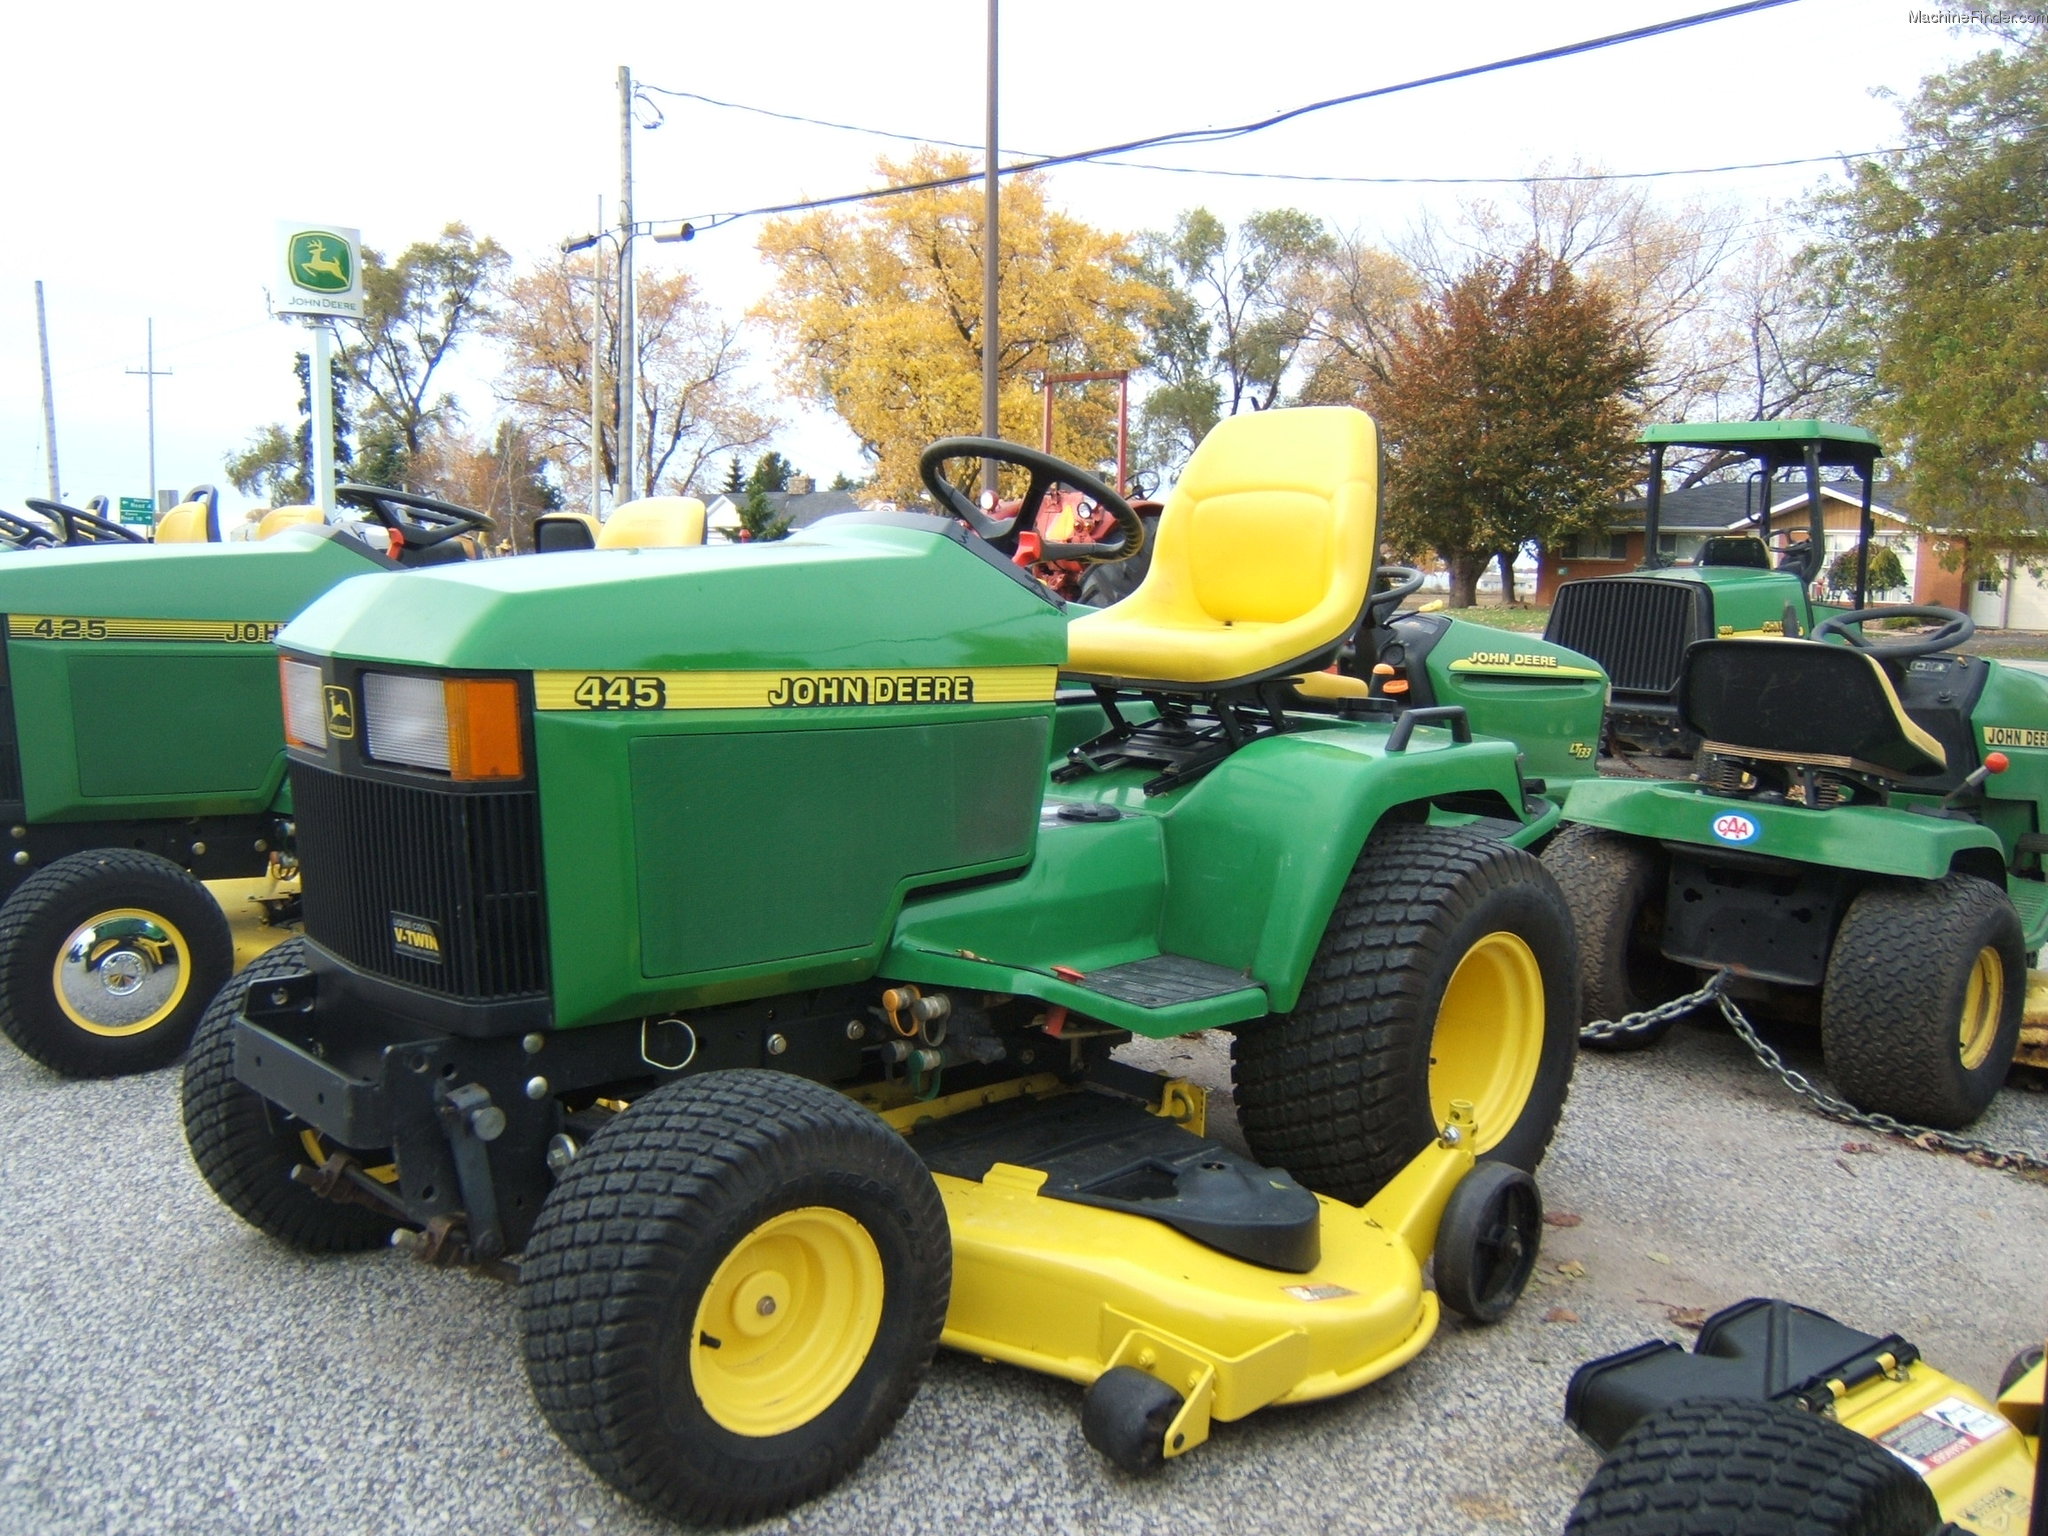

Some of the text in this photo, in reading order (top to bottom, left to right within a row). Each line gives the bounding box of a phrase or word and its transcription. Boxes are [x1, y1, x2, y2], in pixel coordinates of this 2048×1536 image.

[289, 296, 357, 311] JOHN DEERE
[33, 618, 289, 643] 425 JOH
[1468, 652, 1558, 668] JOHN DEERE
[575, 676, 974, 711] 445 JOHN DEERE
[1988, 728, 2048, 747] JOHN DEE
[1717, 817, 1749, 839] CAA
[393, 927, 440, 952] V-TWIN
